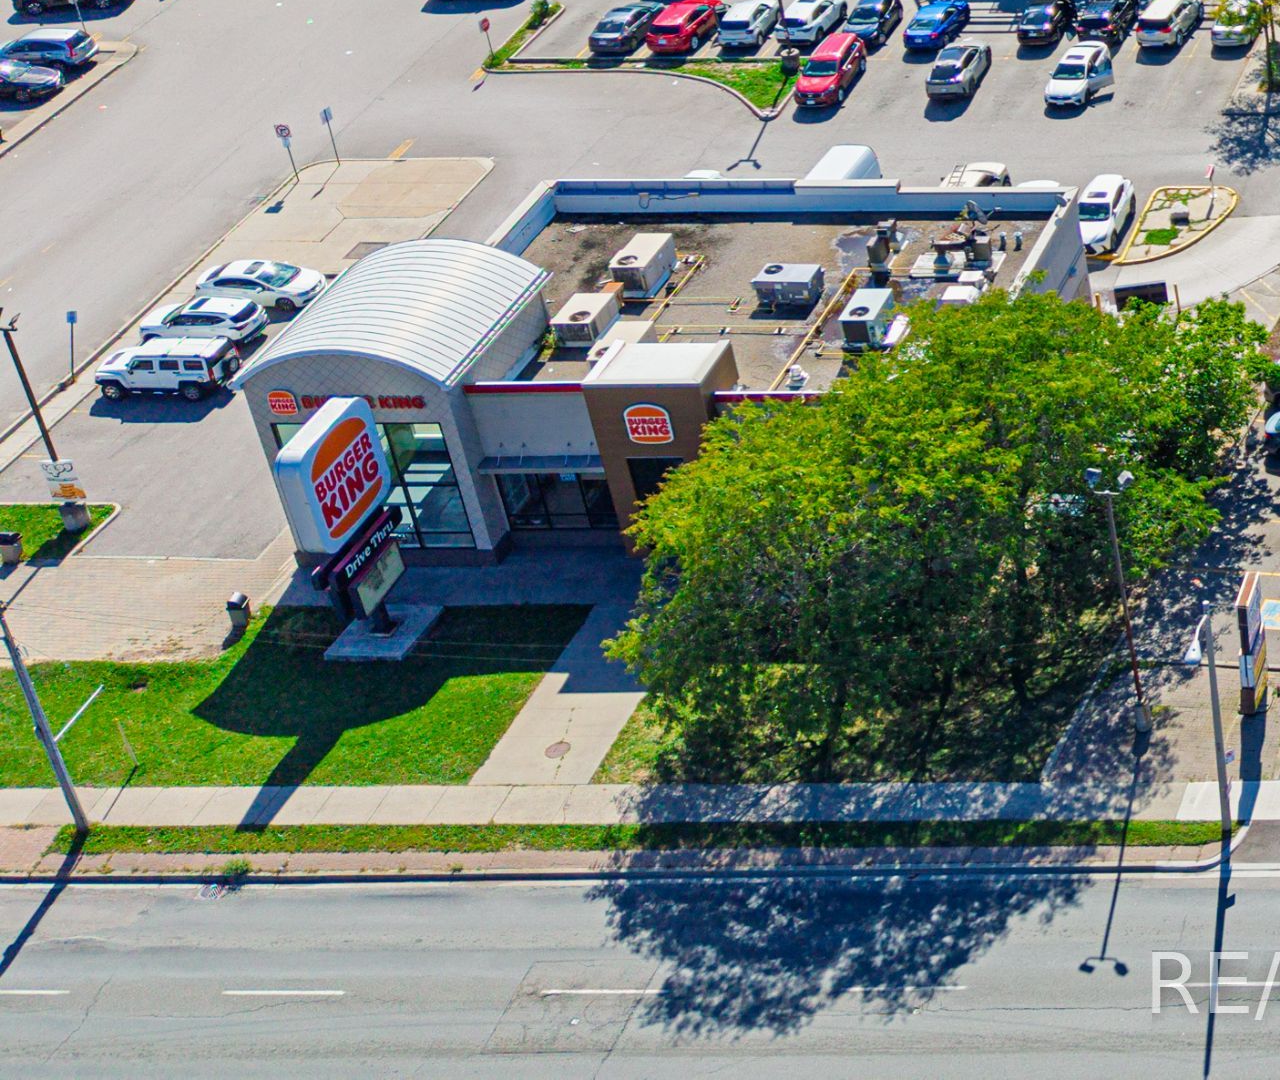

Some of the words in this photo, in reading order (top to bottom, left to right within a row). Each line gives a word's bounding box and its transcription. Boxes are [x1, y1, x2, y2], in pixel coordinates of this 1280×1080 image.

[270, 403, 297, 411] KING
[378, 395, 426, 410] KING
[626, 417, 667, 426] BURGER
[629, 423, 670, 436] KING
[314, 432, 373, 504] BURGER
[321, 451, 379, 529] KING
[344, 548, 372, 579] Drive
[369, 519, 395, 550] Thru
